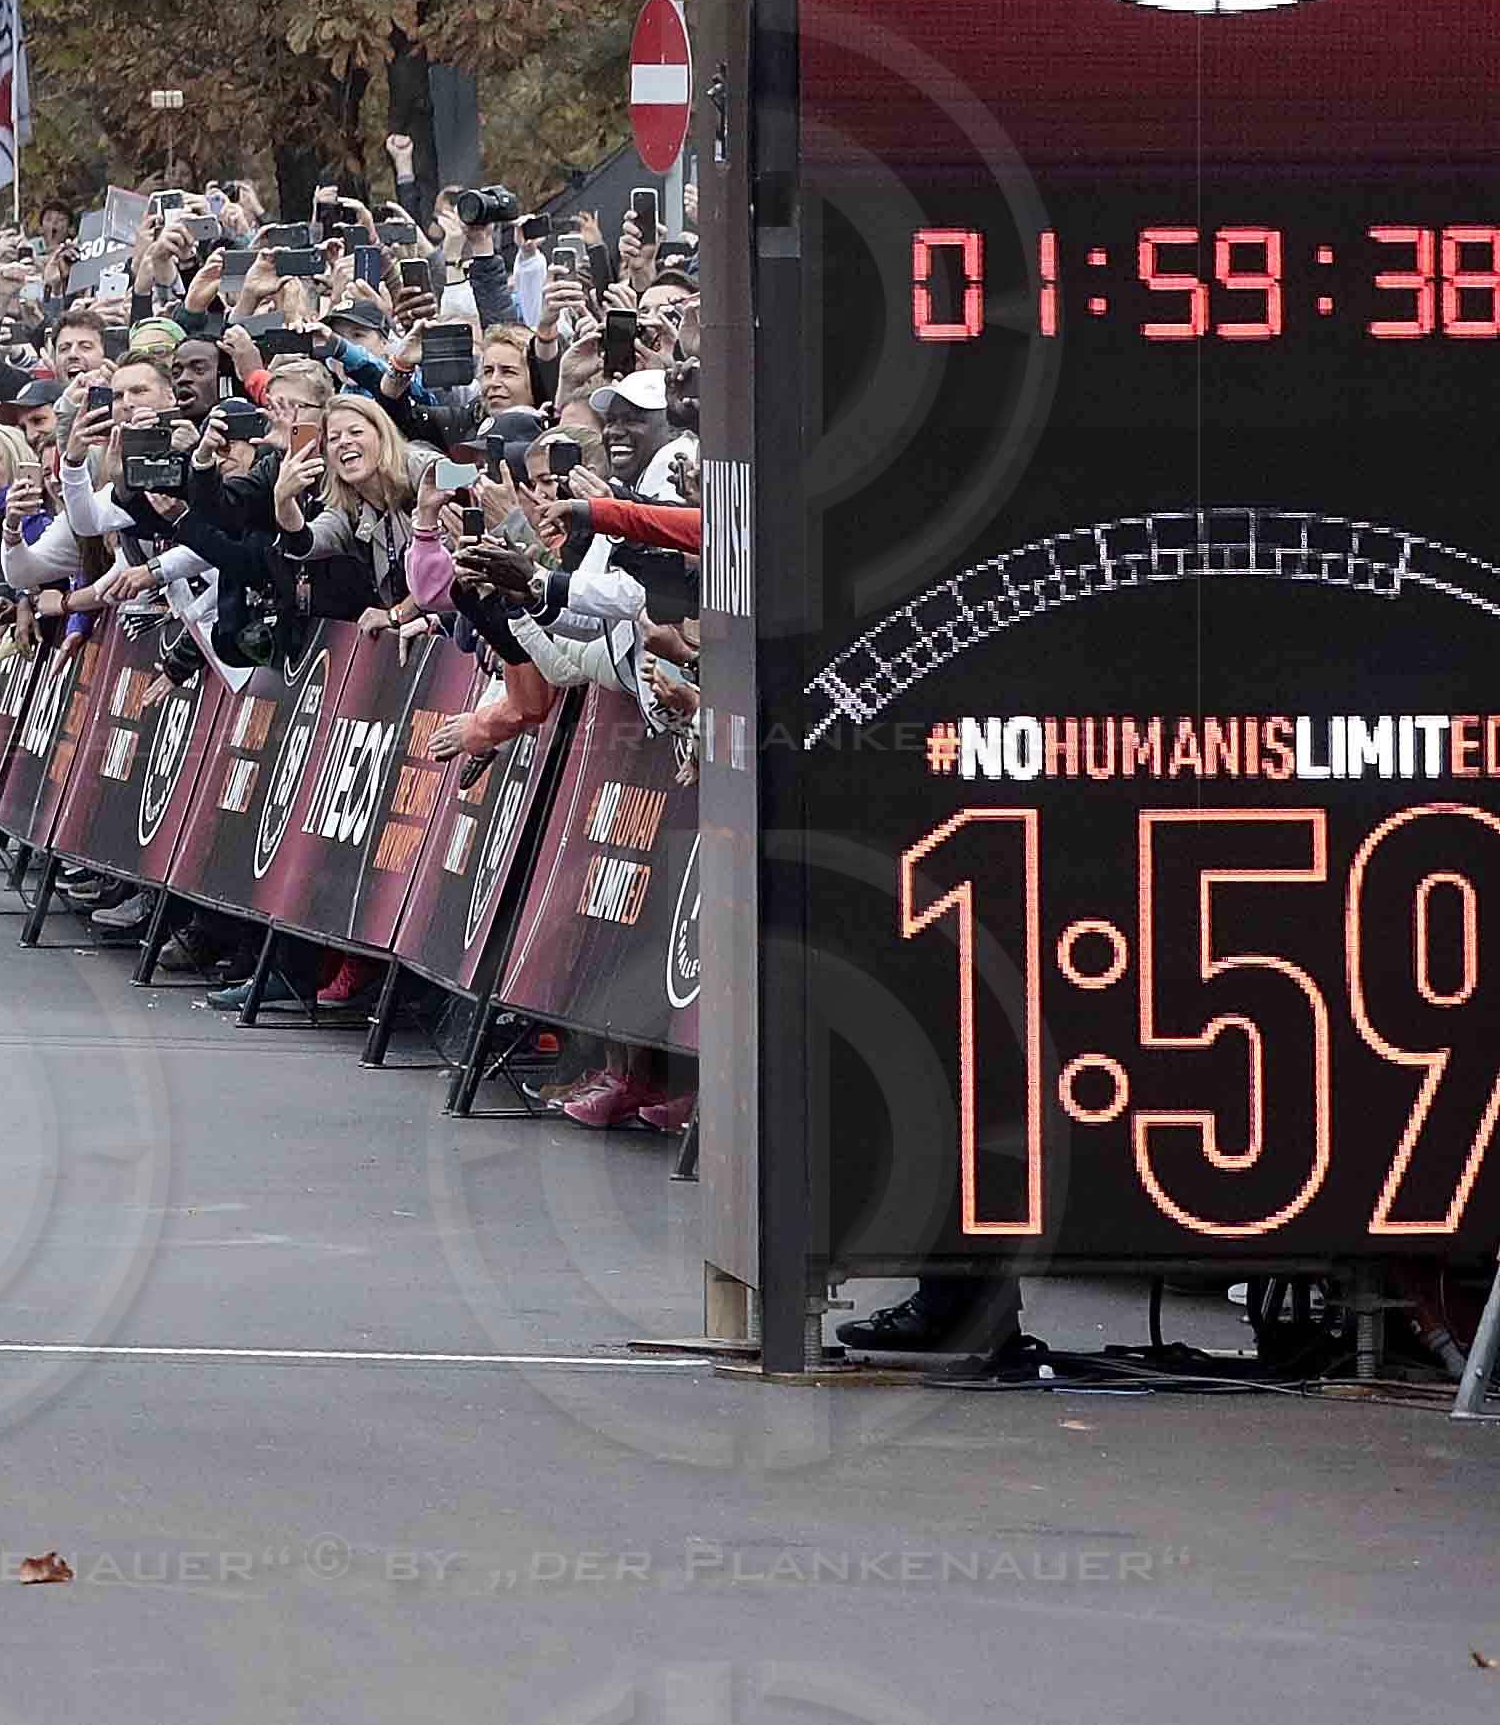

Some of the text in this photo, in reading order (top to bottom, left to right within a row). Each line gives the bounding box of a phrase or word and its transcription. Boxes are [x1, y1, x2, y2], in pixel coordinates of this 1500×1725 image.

[912, 224, 1500, 343] 01:59:38
[702, 458, 751, 617] FINISH
[300, 716, 396, 847] INEOS
[900, 802, 1500, 1239] 1:59
